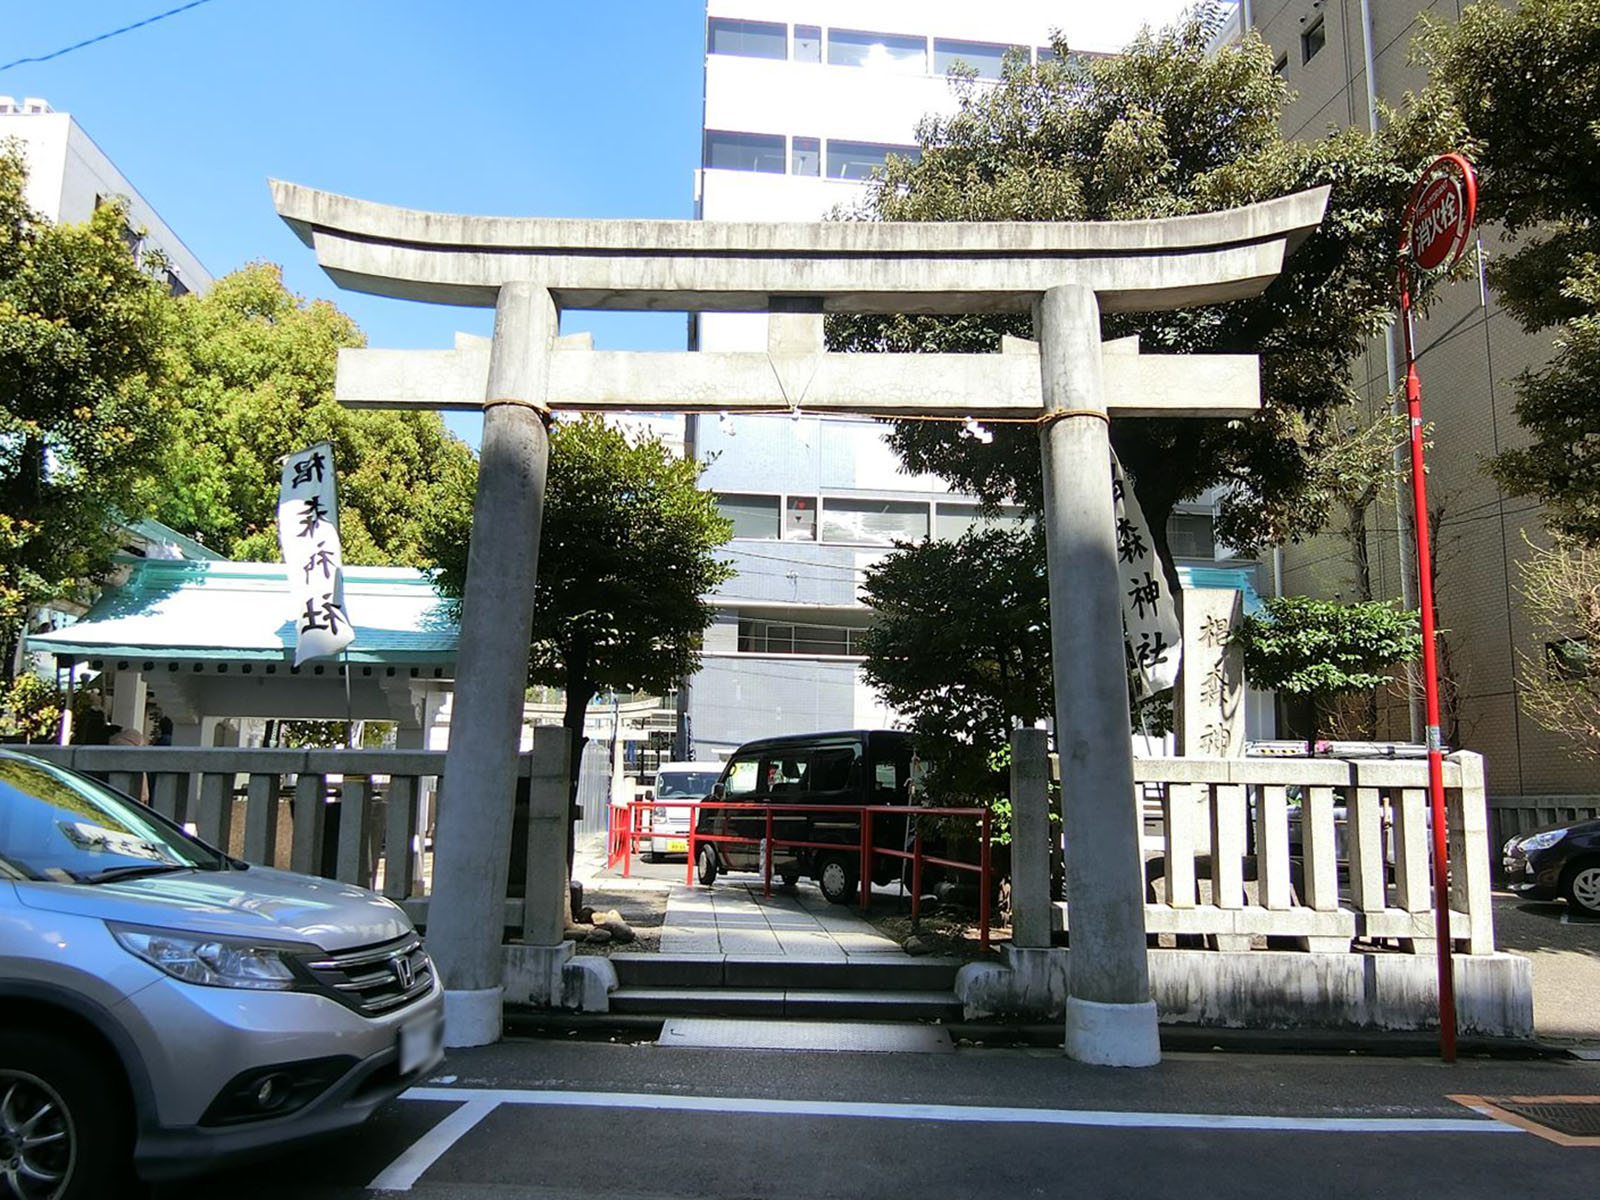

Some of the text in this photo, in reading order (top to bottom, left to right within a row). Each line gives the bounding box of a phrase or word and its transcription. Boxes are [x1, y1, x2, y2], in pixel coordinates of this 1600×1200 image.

[1415, 192, 1458, 257] 消火栓
[1198, 614, 1232, 803] 椙森神
